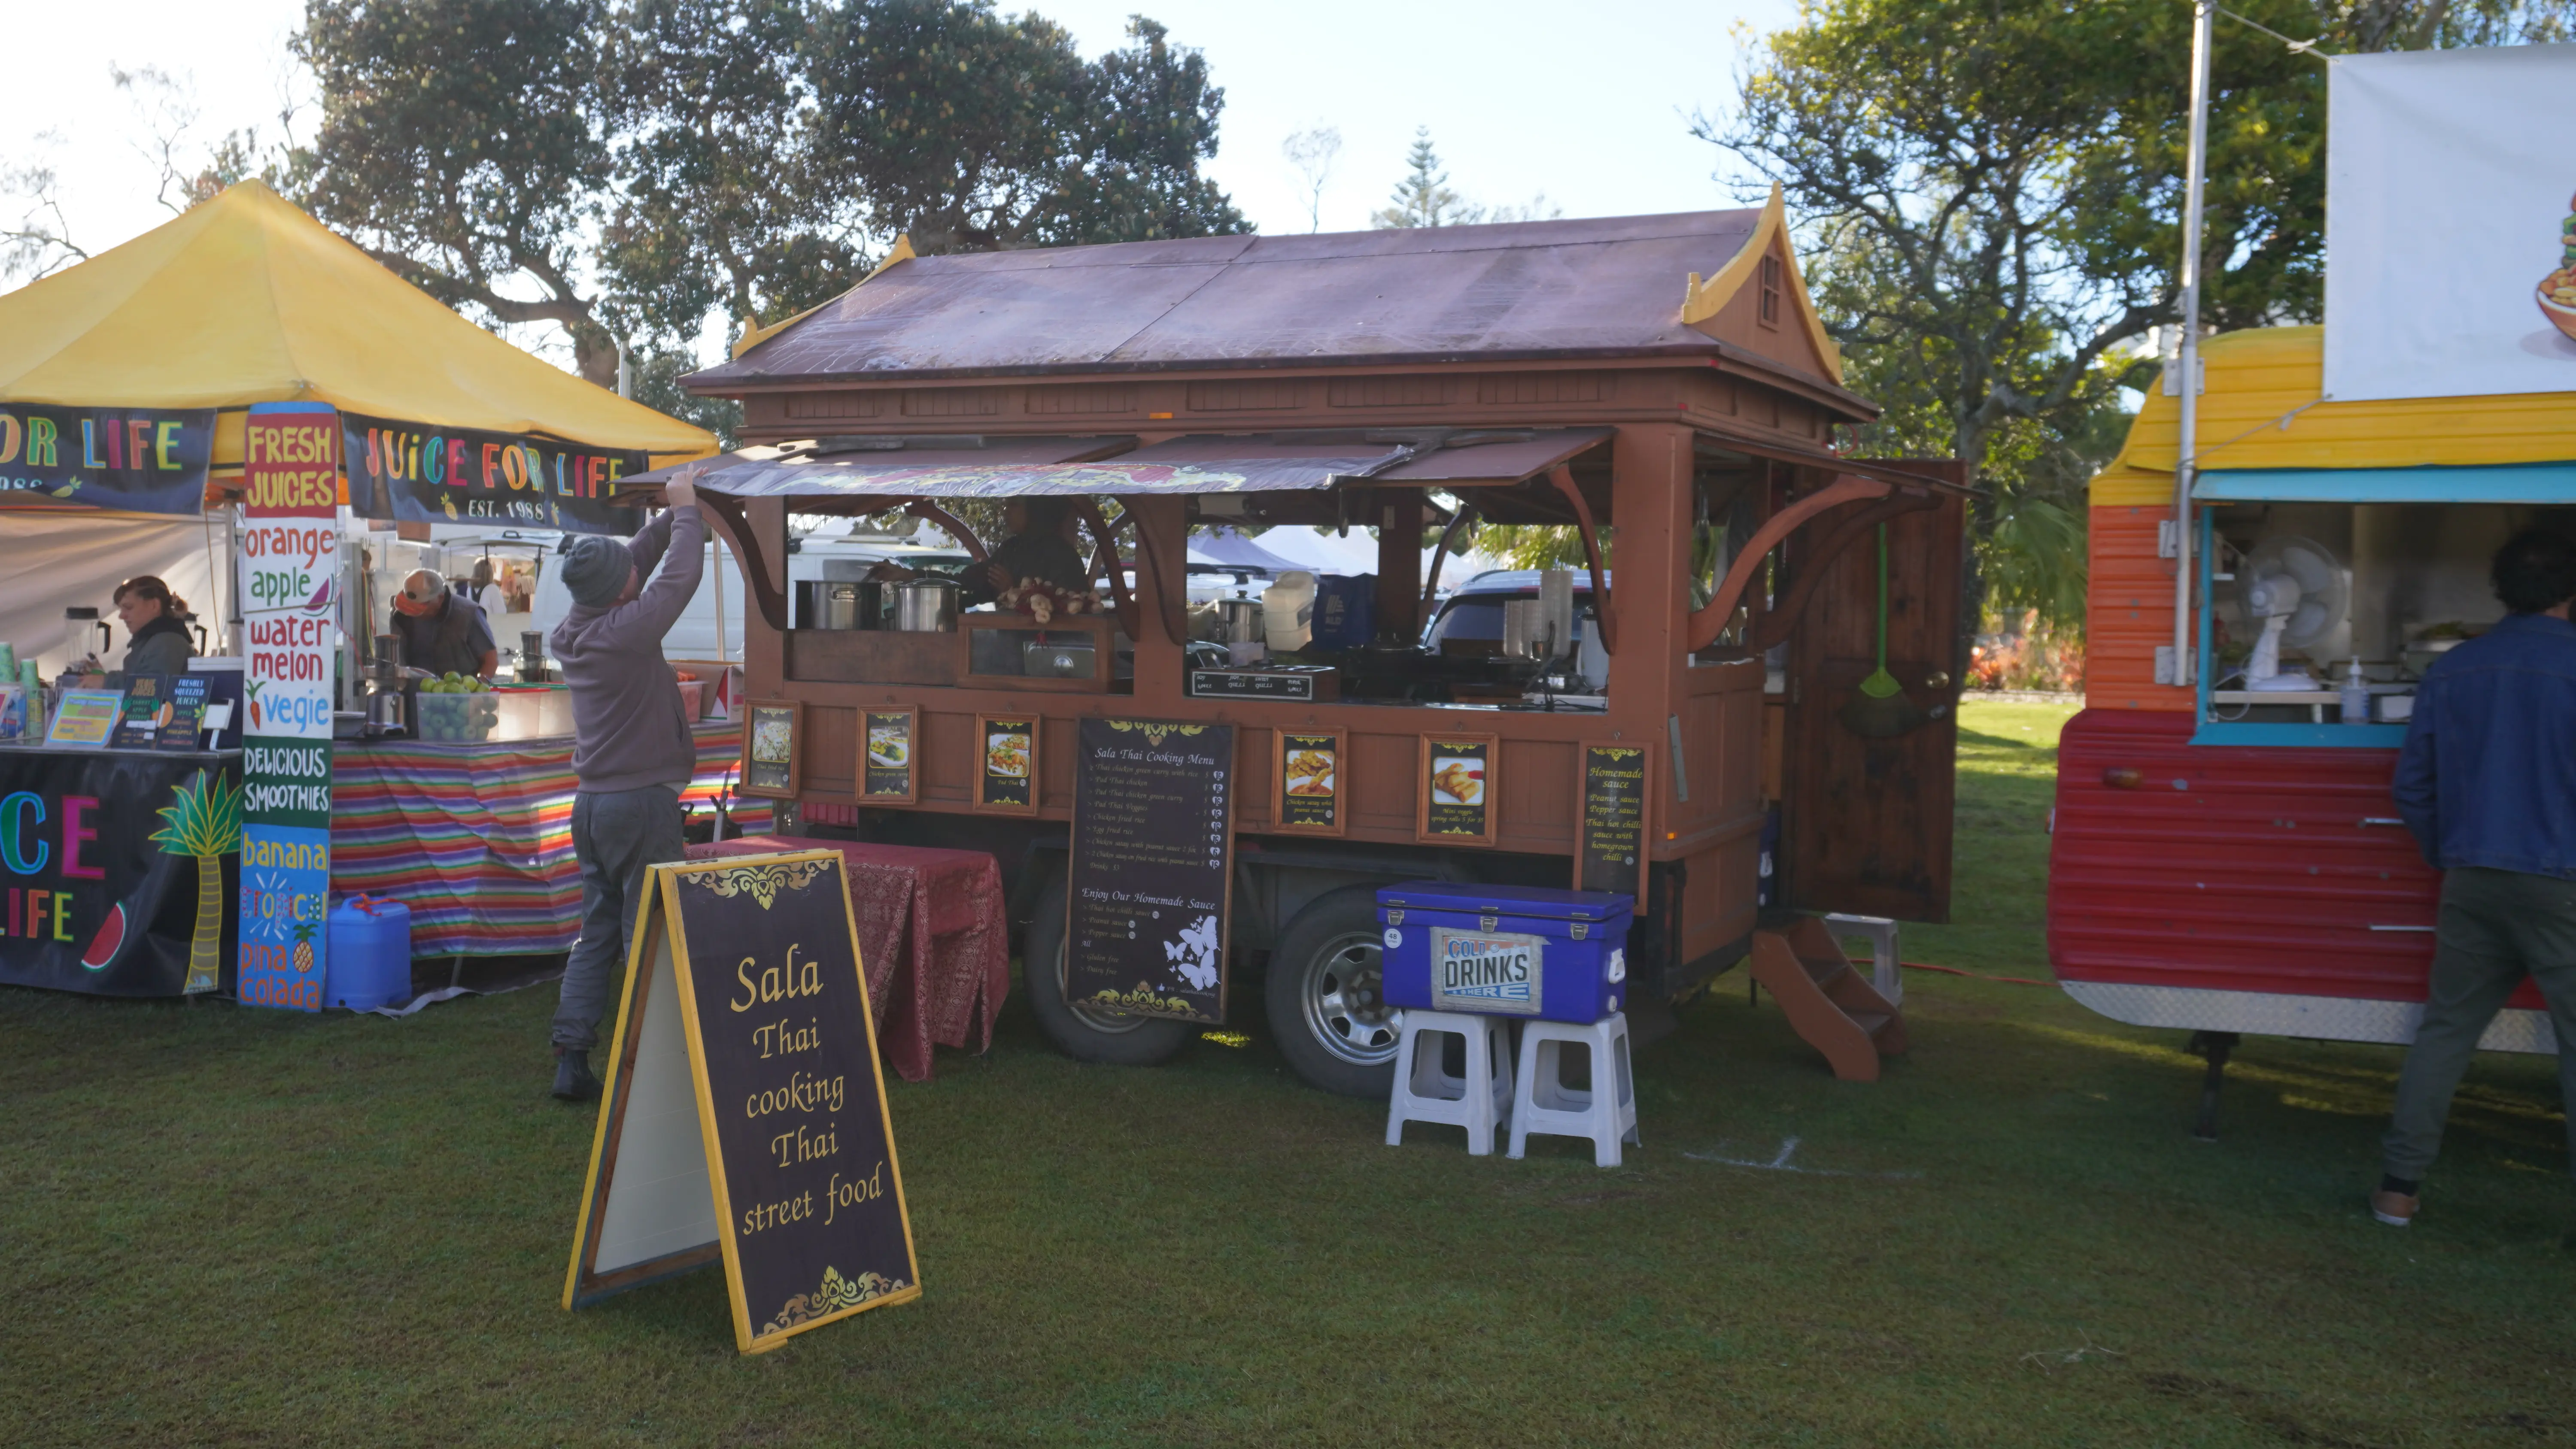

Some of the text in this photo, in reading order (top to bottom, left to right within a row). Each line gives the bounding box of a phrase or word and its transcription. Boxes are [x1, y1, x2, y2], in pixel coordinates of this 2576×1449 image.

[81, 418, 183, 470] LIFE
[248, 426, 331, 464] FRESH
[482, 443, 544, 493] FOR
[556, 452, 623, 499] LIFE
[246, 470, 333, 509] JUICES
[468, 499, 544, 521] EST. 1988
[245, 527, 335, 570] orange
[250, 567, 311, 606] apple
[250, 615, 331, 647] water
[252, 650, 322, 682] melon
[174, 688, 204, 697] SQUEEZED
[178, 679, 204, 688] FRESHLY
[176, 697, 199, 705] JUICES
[263, 689, 329, 733] vegie
[244, 747, 326, 778] DELICIOUS
[1094, 747, 1215, 767] Sala Thai Cooking Menu
[1096, 764, 1110, 772] Thai
[1112, 765, 1134, 773] chicken
[1153, 769, 1170, 777] curry
[1589, 766, 1643, 779] Homemade
[1127, 779, 1148, 787] chicken
[1215, 785, 1221, 793] 16
[1602, 780, 1629, 789] sauce
[244, 782, 329, 813] SMOOTHIES
[1126, 791, 1148, 799] chicken
[1214, 797, 1221, 806] 16
[1590, 794, 1618, 804] Peanut
[1126, 803, 1148, 812] Veggies
[1214, 810, 1220, 818] 16
[1590, 805, 1616, 815] Pepper
[1093, 812, 1116, 822] Chicken
[1116, 814, 1133, 823] fried
[1213, 822, 1219, 831] 16
[1467, 816, 1476, 824] for
[1586, 818, 1642, 829] Thai hot chilli
[1616, 832, 1634, 840] with
[243, 832, 327, 871] banana
[1092, 838, 1113, 847] Chicken
[1213, 847, 1218, 857] 6
[1592, 840, 1634, 852] homegrown
[1090, 861, 1108, 871] Drinks
[1211, 861, 1217, 869] 16
[1603, 853, 1622, 862] chilli
[240, 885, 326, 929] tropical
[1081, 887, 1215, 910] Enjoy Our Homemade Sauce
[1089, 903, 1104, 912] Thai
[1106, 905, 1115, 913] hot
[0, 888, 74, 942] IFE
[1088, 916, 1109, 925] Peanut
[1088, 928, 1109, 938] Pepper
[240, 937, 287, 977] pina
[1448, 940, 1485, 959] COLD
[1107, 955, 1120, 964] free
[730, 943, 824, 1012] Sala
[1085, 965, 1117, 976] Dairy free
[1445, 953, 1528, 988] DRINKS
[240, 974, 319, 1010] colada
[1467, 983, 1529, 1000] HERE
[753, 1016, 821, 1059] Thai
[746, 1071, 844, 1118] cooking
[771, 1122, 839, 1168] Thai
[742, 1161, 884, 1235] street food
